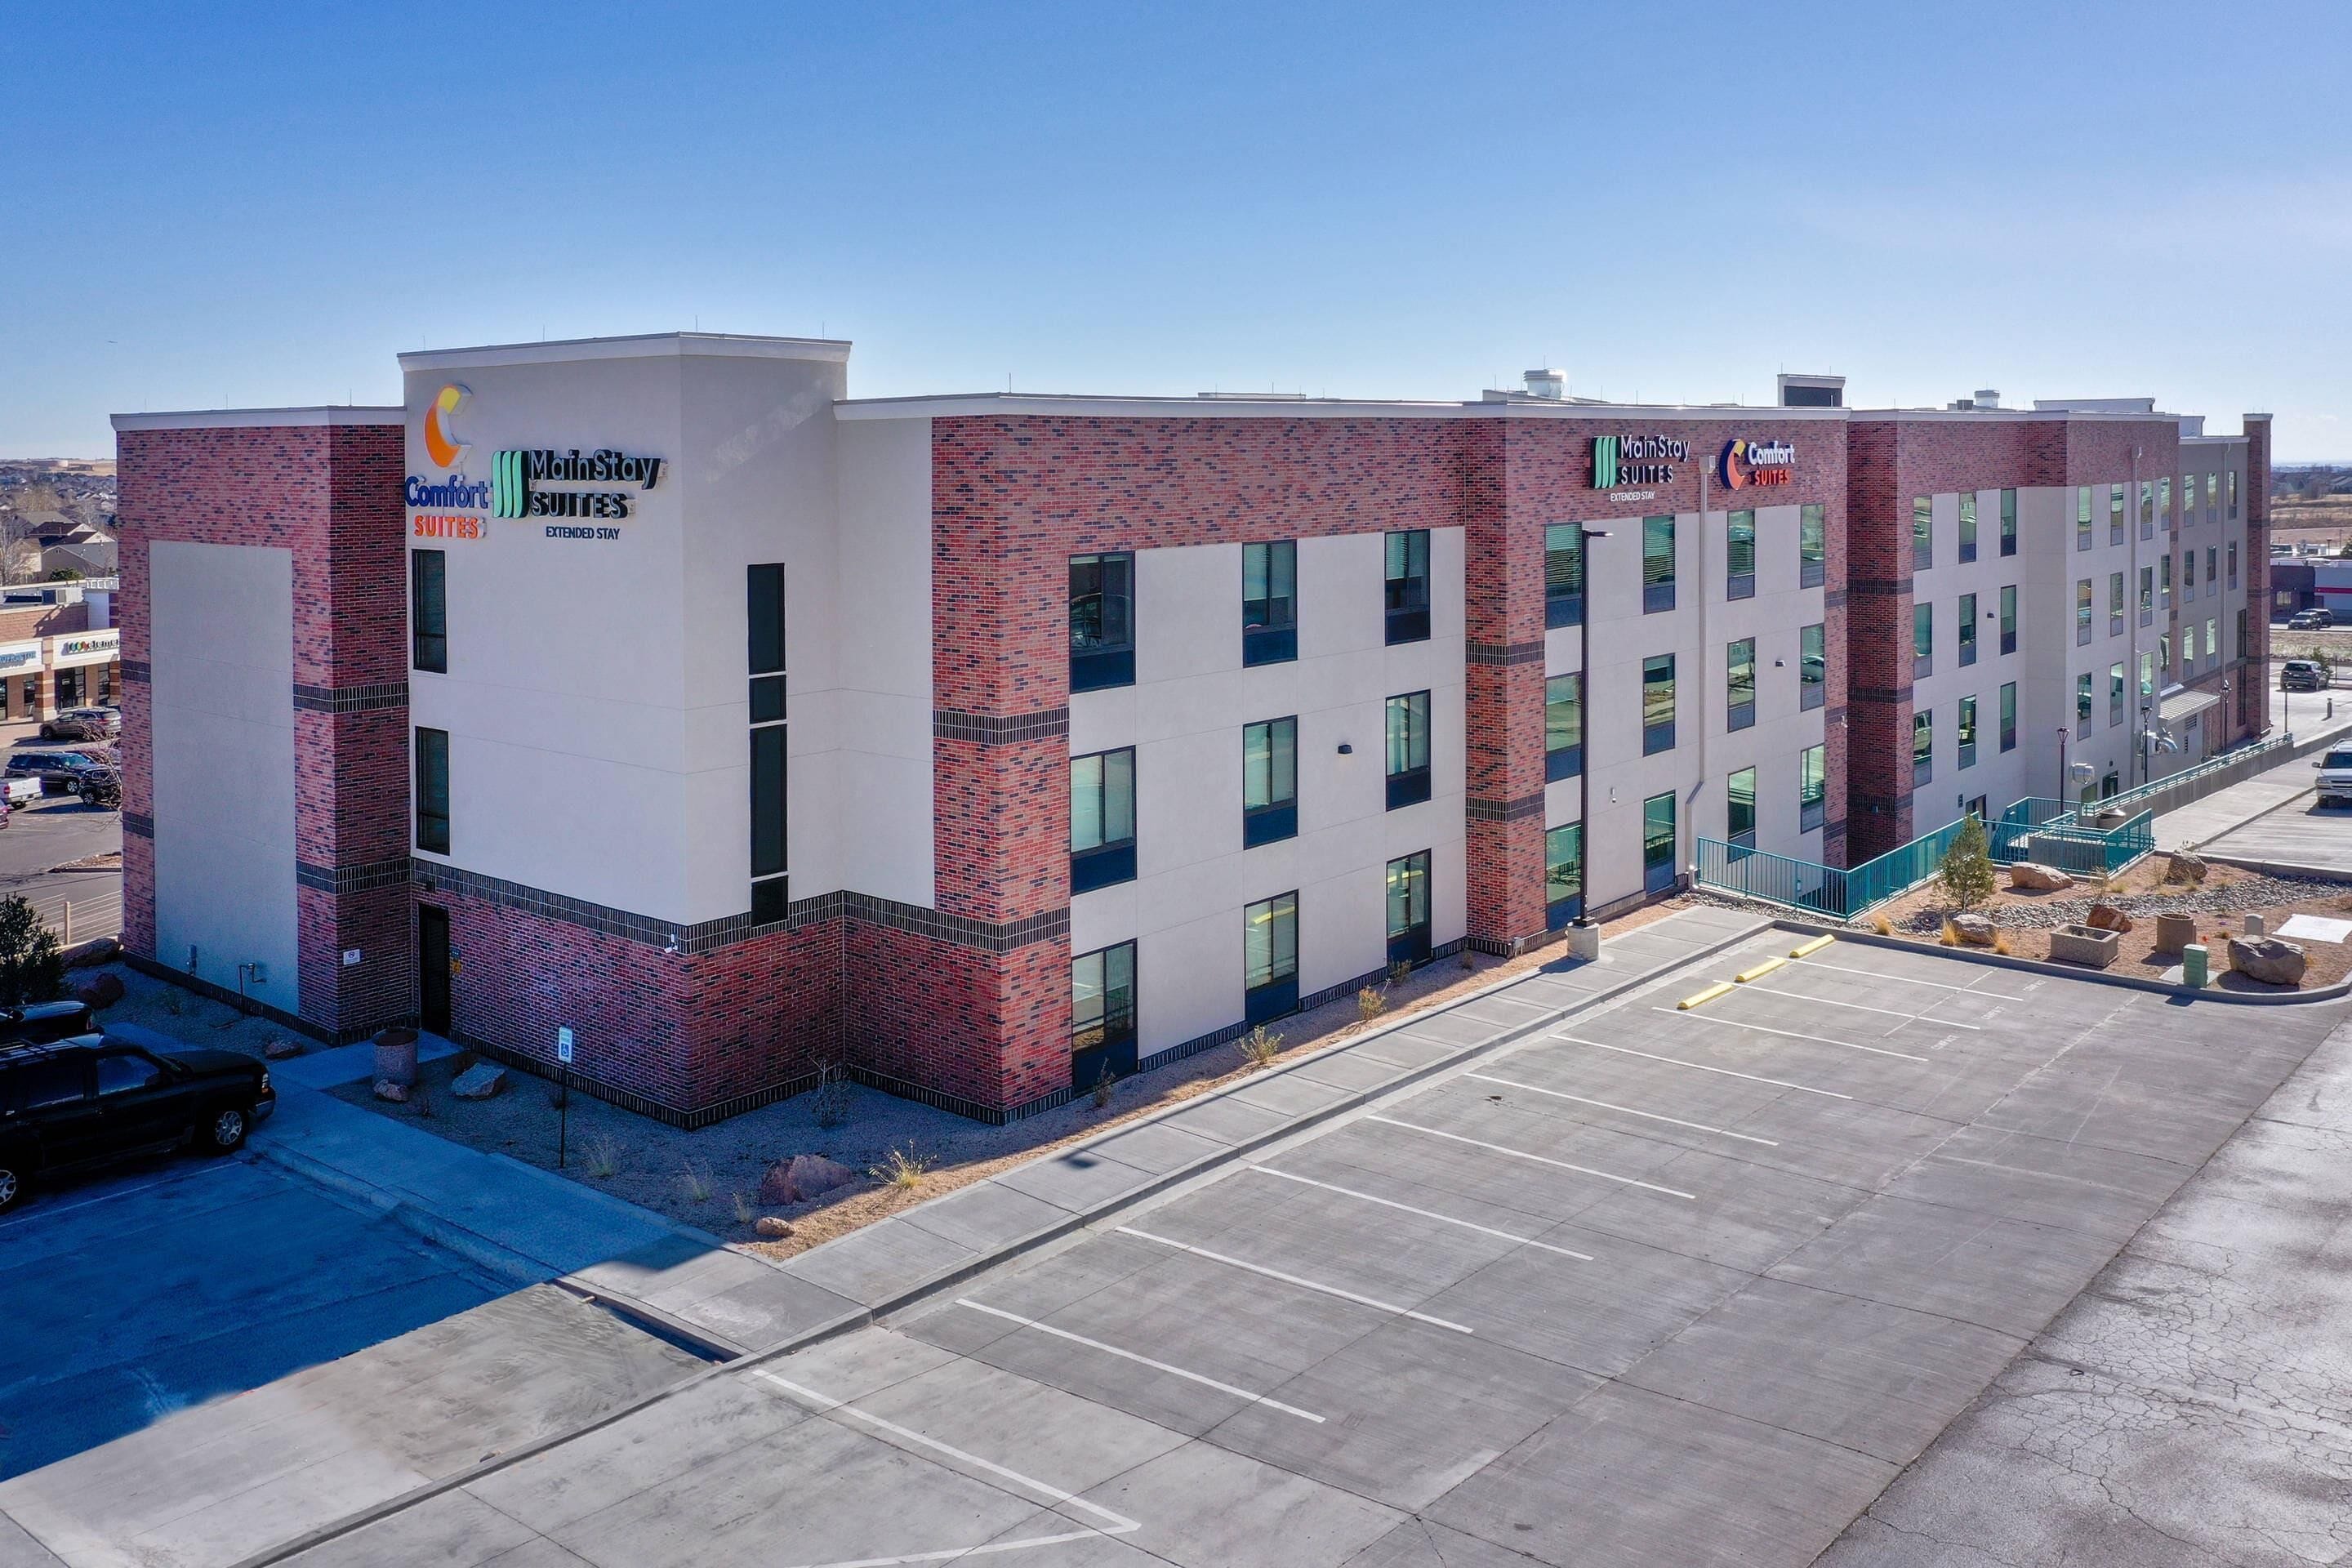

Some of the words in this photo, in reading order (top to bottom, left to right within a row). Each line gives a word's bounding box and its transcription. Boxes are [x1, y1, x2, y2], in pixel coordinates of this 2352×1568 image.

[1620, 434, 1690, 463] MainStay
[1748, 441, 1795, 466] Comfort
[531, 449, 658, 490] MainStay
[1621, 465, 1673, 484] SUITES
[1755, 470, 1790, 485] SUITES
[405, 474, 488, 509] Comfort
[1610, 492, 1641, 501] EXTENDED
[1641, 491, 1655, 500] STAY
[532, 492, 627, 519] SUITES
[414, 515, 479, 539] SUITES
[546, 526, 595, 539] EXTENDED
[596, 528, 620, 540] STAY
